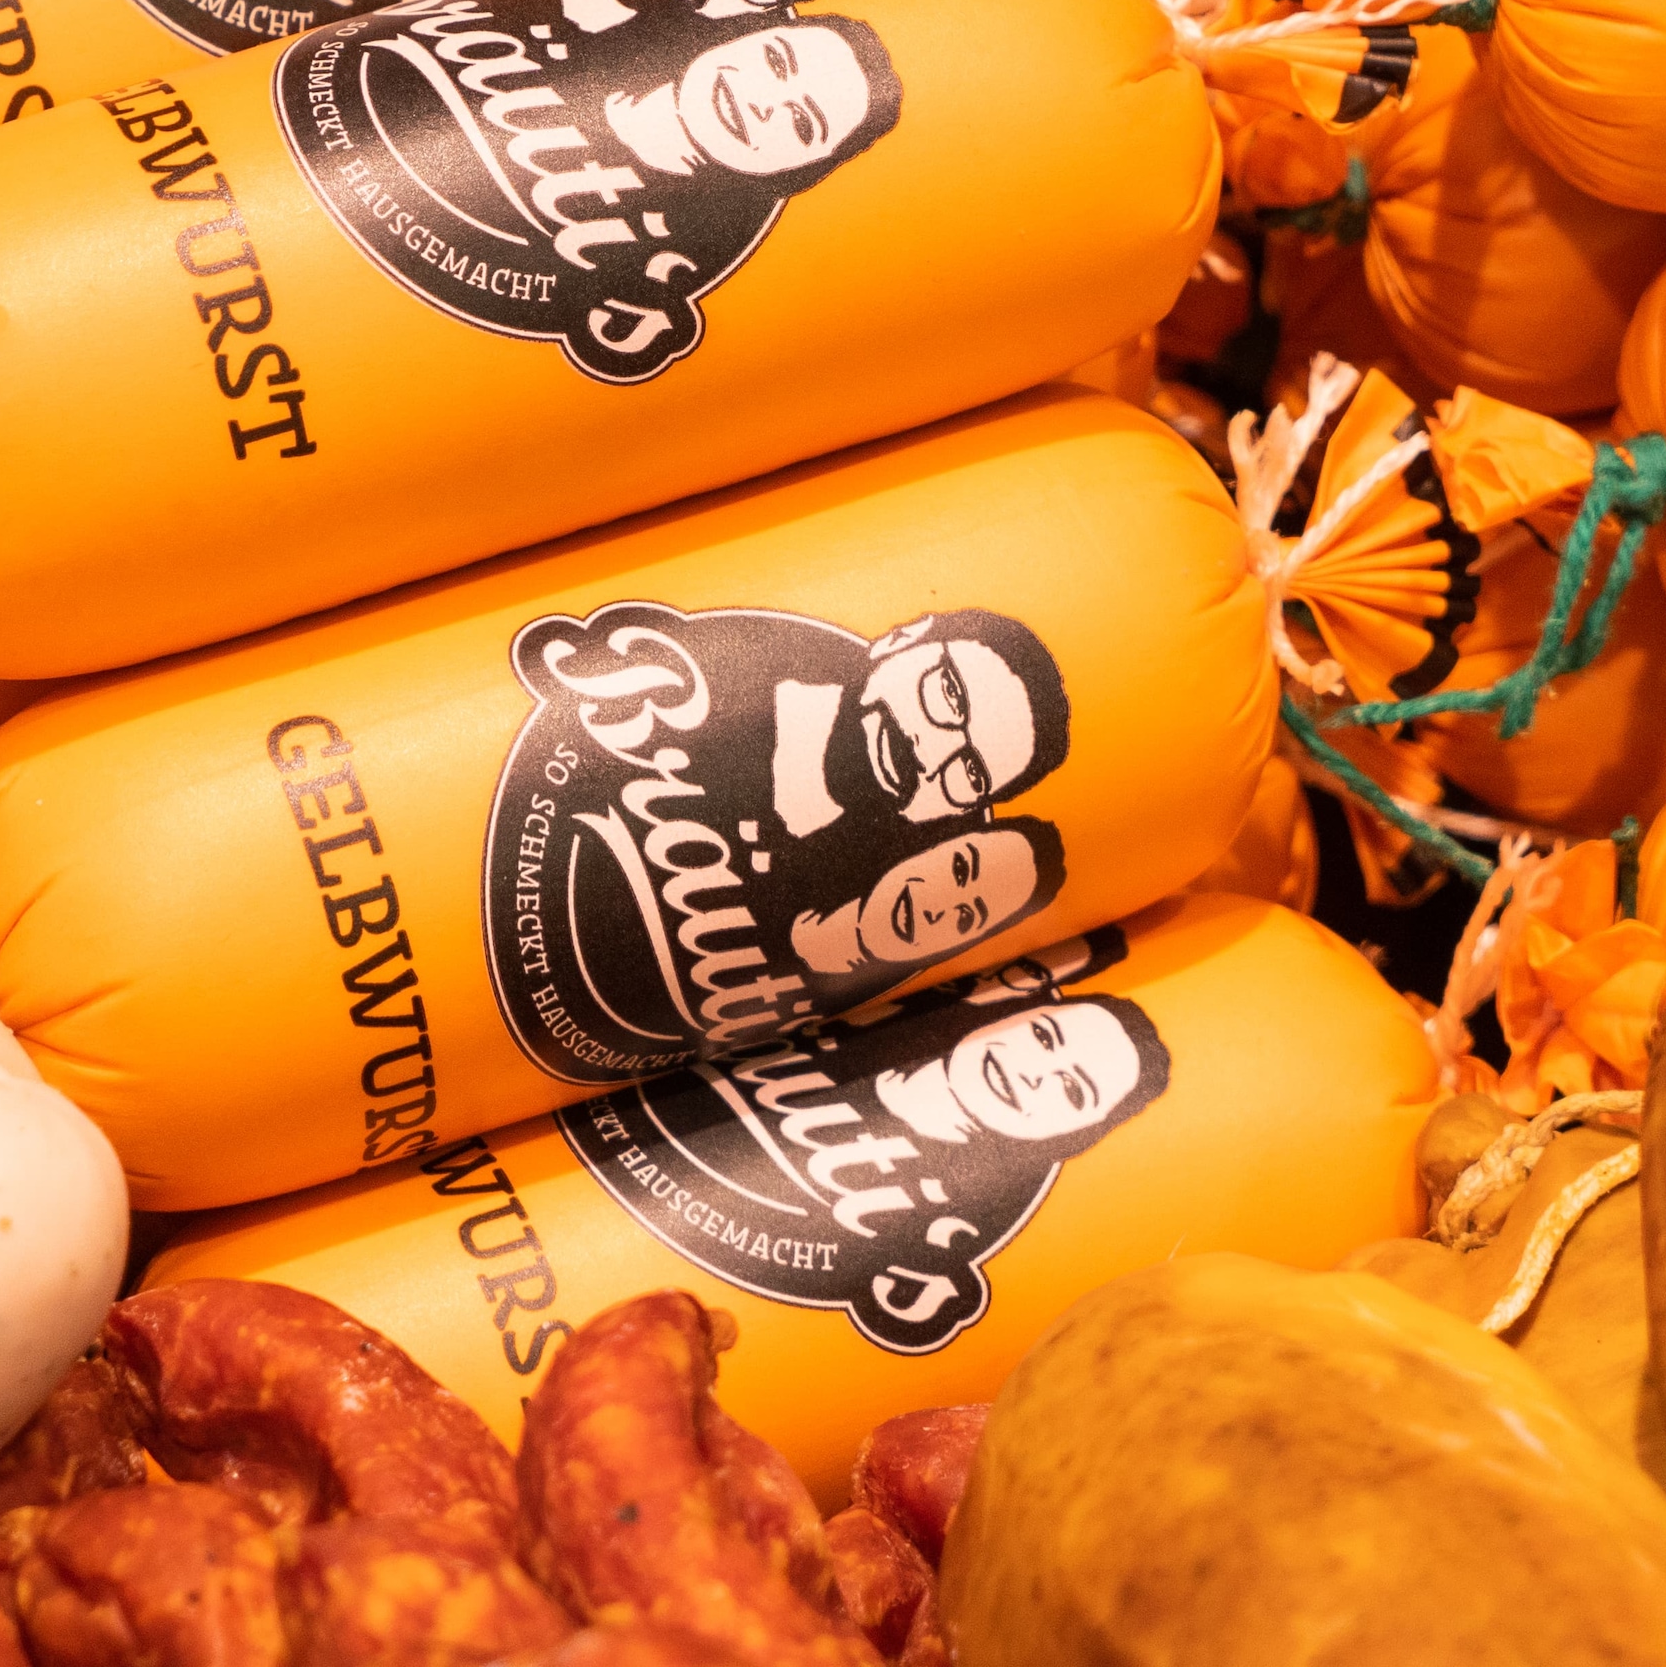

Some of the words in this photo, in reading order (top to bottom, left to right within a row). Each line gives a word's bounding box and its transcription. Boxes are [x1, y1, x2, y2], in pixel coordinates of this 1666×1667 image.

[335, 20, 369, 37] SO
[308, 39, 354, 152] SCHMECKT
[339, 157, 558, 302] HAUSGEMACHT
[544, 741, 580, 786] SO
[516, 793, 556, 976] SCHMECKT
[531, 982, 696, 1071] HAUSGEMACHT
[617, 1145, 839, 1271] HAUSGEMACHT
